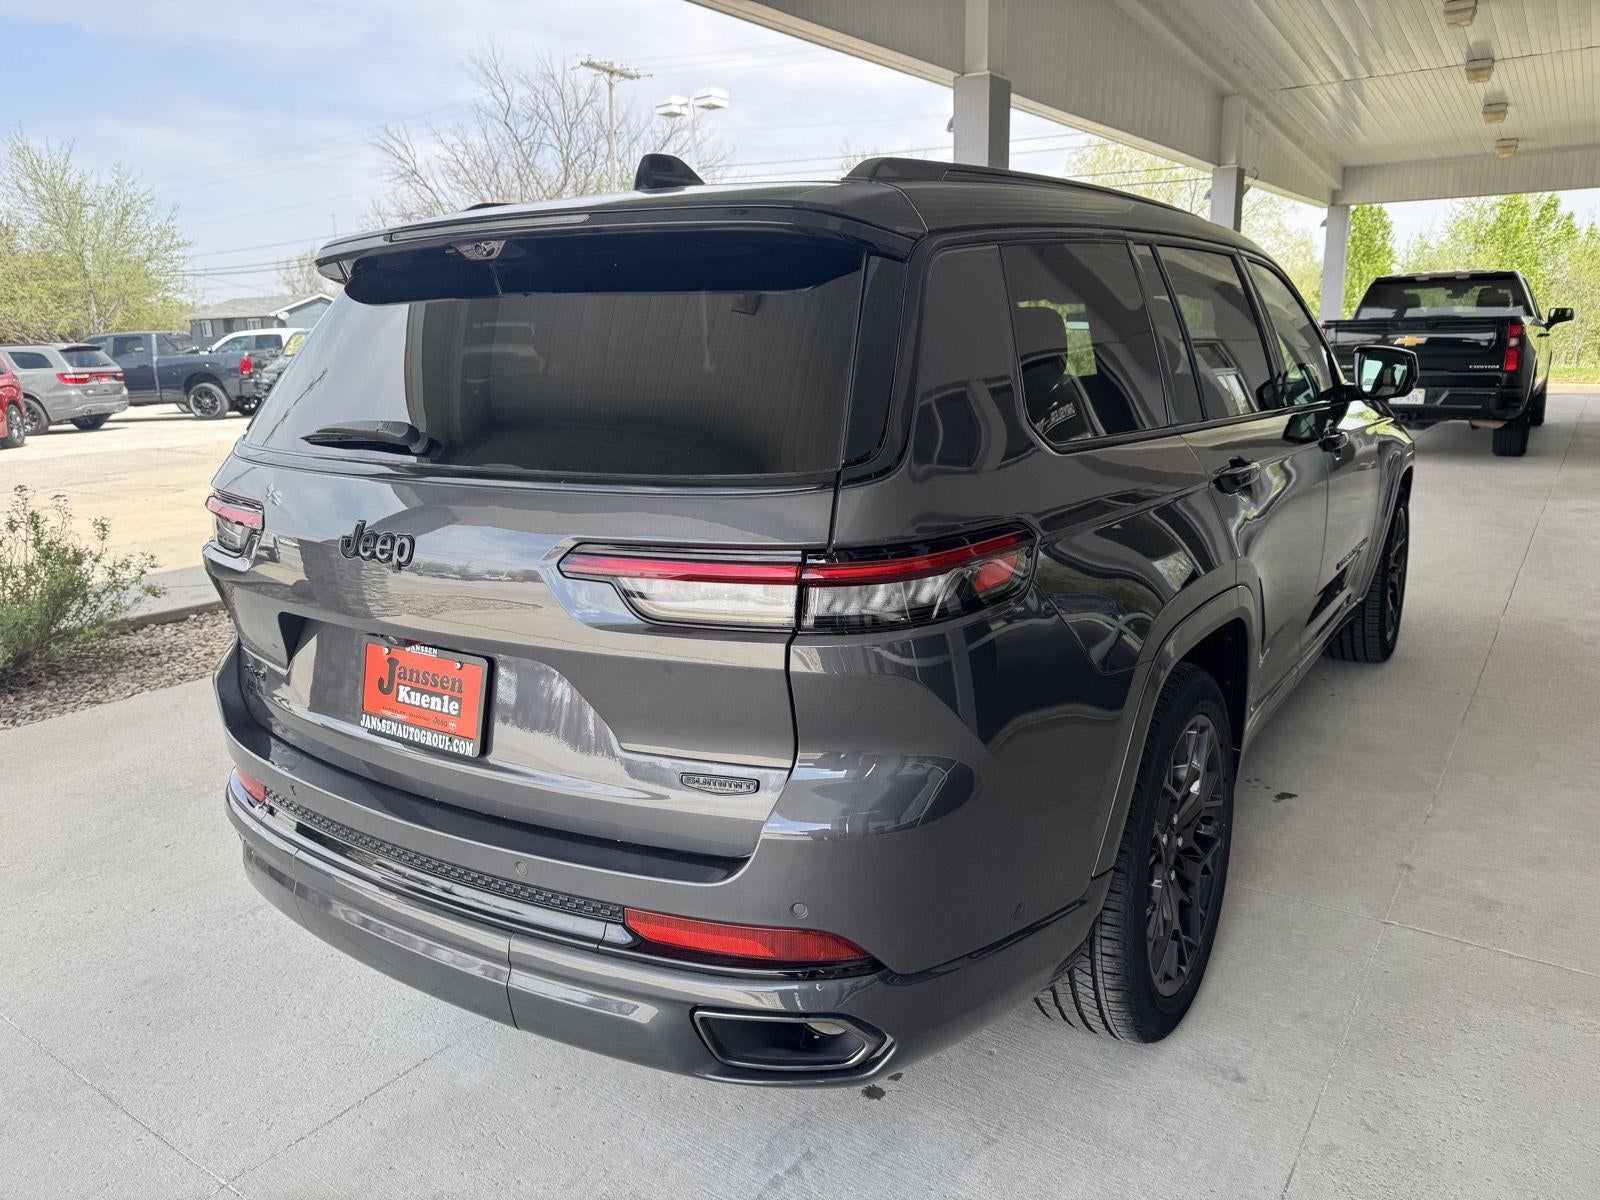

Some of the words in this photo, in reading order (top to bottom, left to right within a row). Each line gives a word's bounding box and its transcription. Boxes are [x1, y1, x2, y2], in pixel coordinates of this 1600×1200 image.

[339, 520, 416, 573] Jeep
[404, 644, 438, 656] JANSSEN
[377, 657, 463, 695] Janssen
[397, 685, 459, 715] Kuenle
